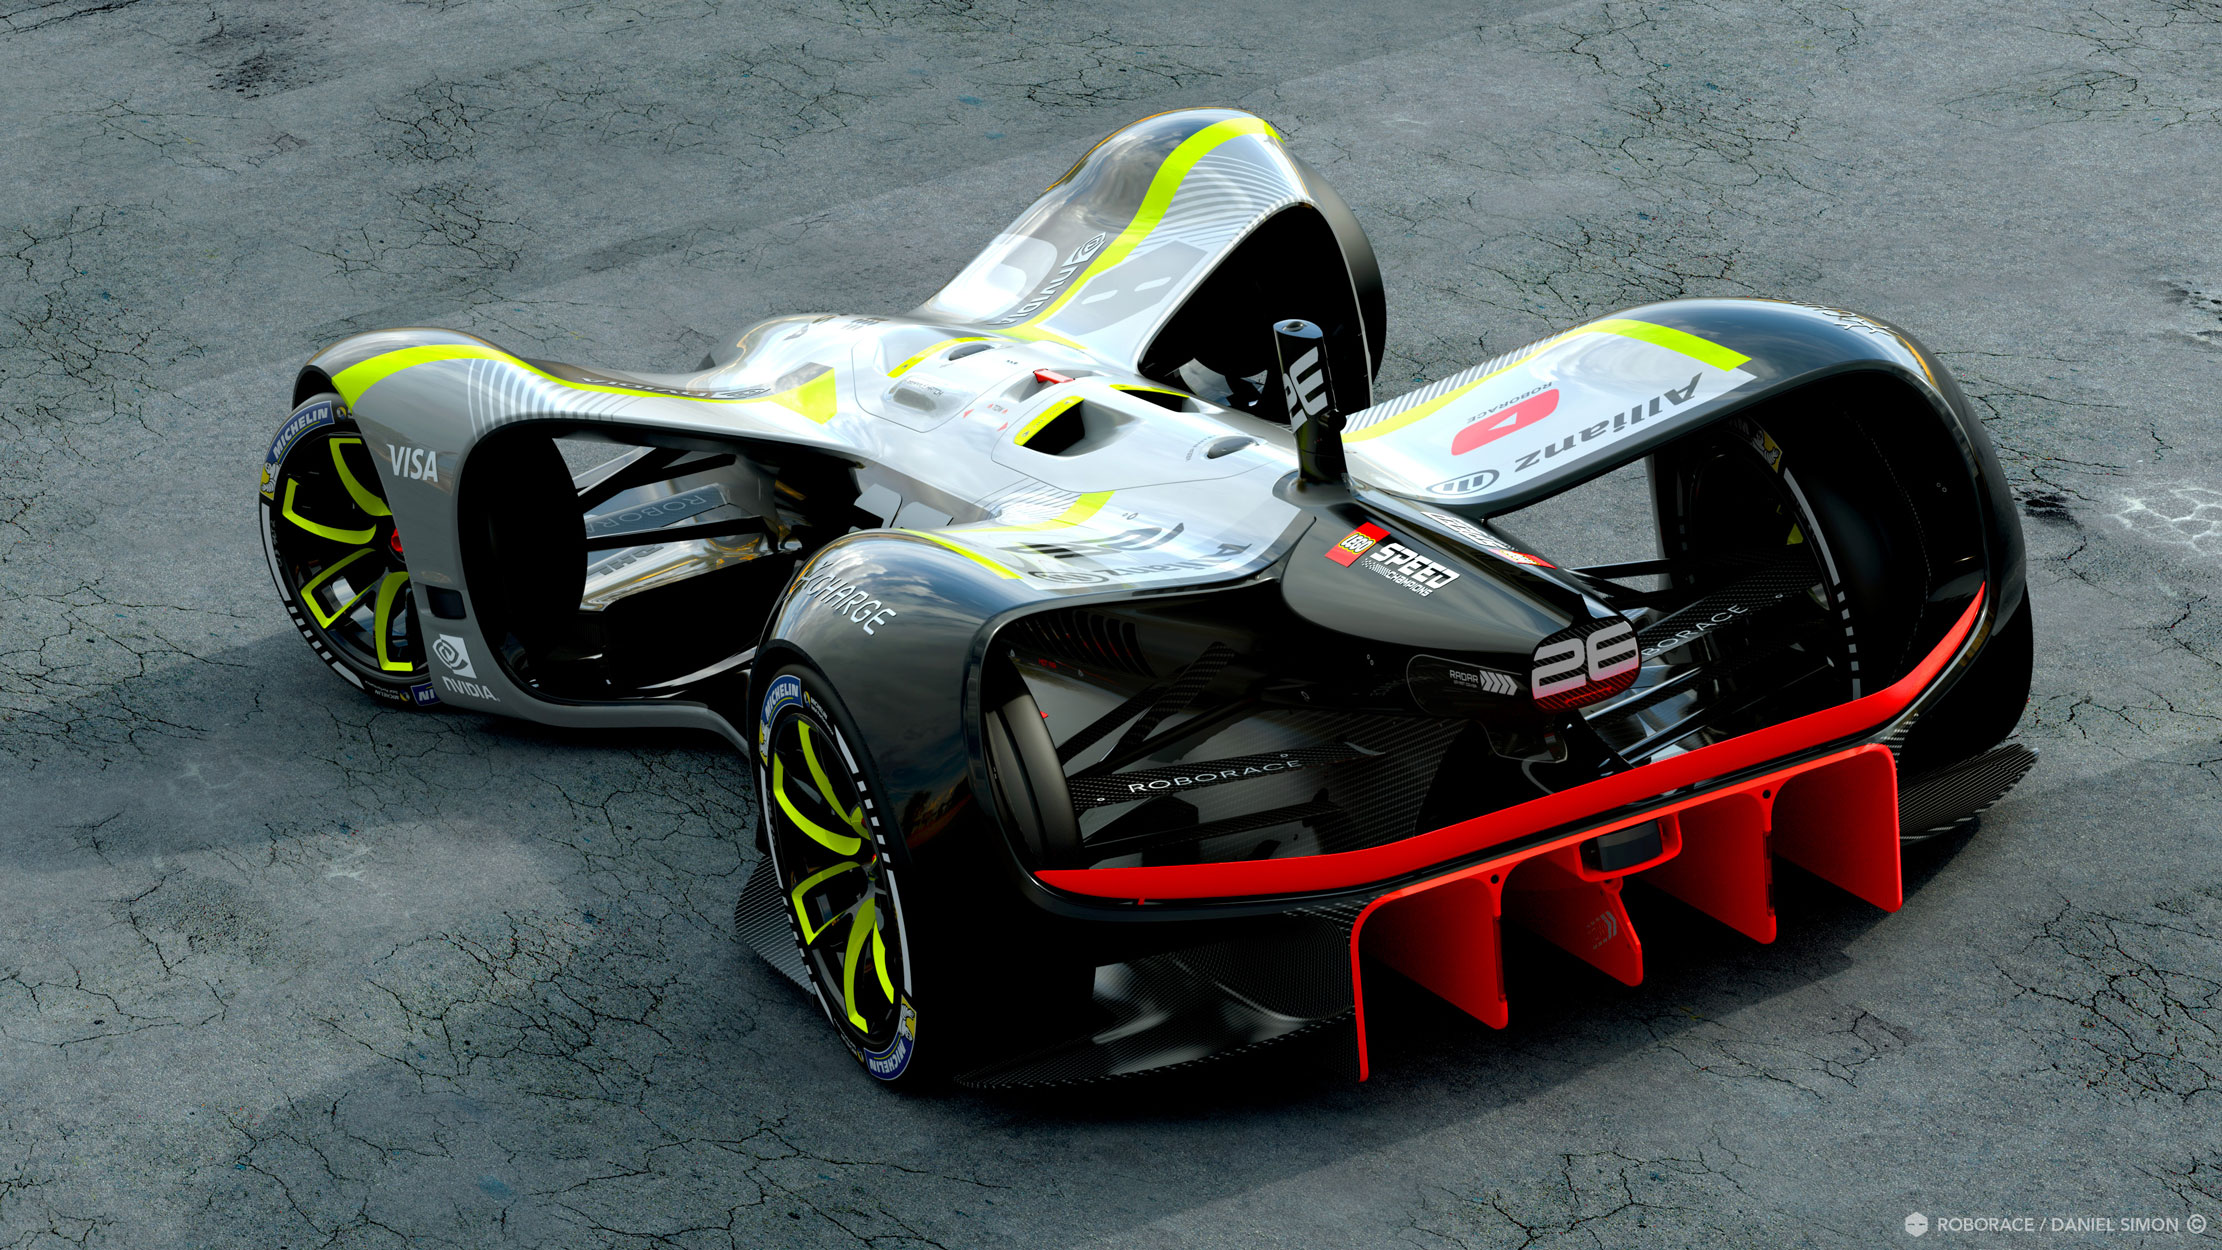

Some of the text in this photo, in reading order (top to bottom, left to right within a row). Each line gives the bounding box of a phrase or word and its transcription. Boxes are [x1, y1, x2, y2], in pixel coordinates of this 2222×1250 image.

[984, 265, 1079, 325] NVIDIA
[1467, 381, 1552, 424] ROBORACE
[1514, 372, 1703, 473] Allianz
[272, 408, 328, 459] MICHELIN
[386, 443, 438, 482] VISA
[1340, 533, 1375, 554] LEGO
[1370, 542, 1460, 589] SPEED
[1641, 604, 1748, 656] BORACE
[1450, 669, 1480, 684] RADAR
[1532, 620, 1639, 700] 26
[442, 676, 499, 701] NVIDIA
[765, 683, 799, 721] MICHELIN
[1128, 760, 1302, 793] ROBORACE
[869, 1038, 906, 1074] MICHELIN
